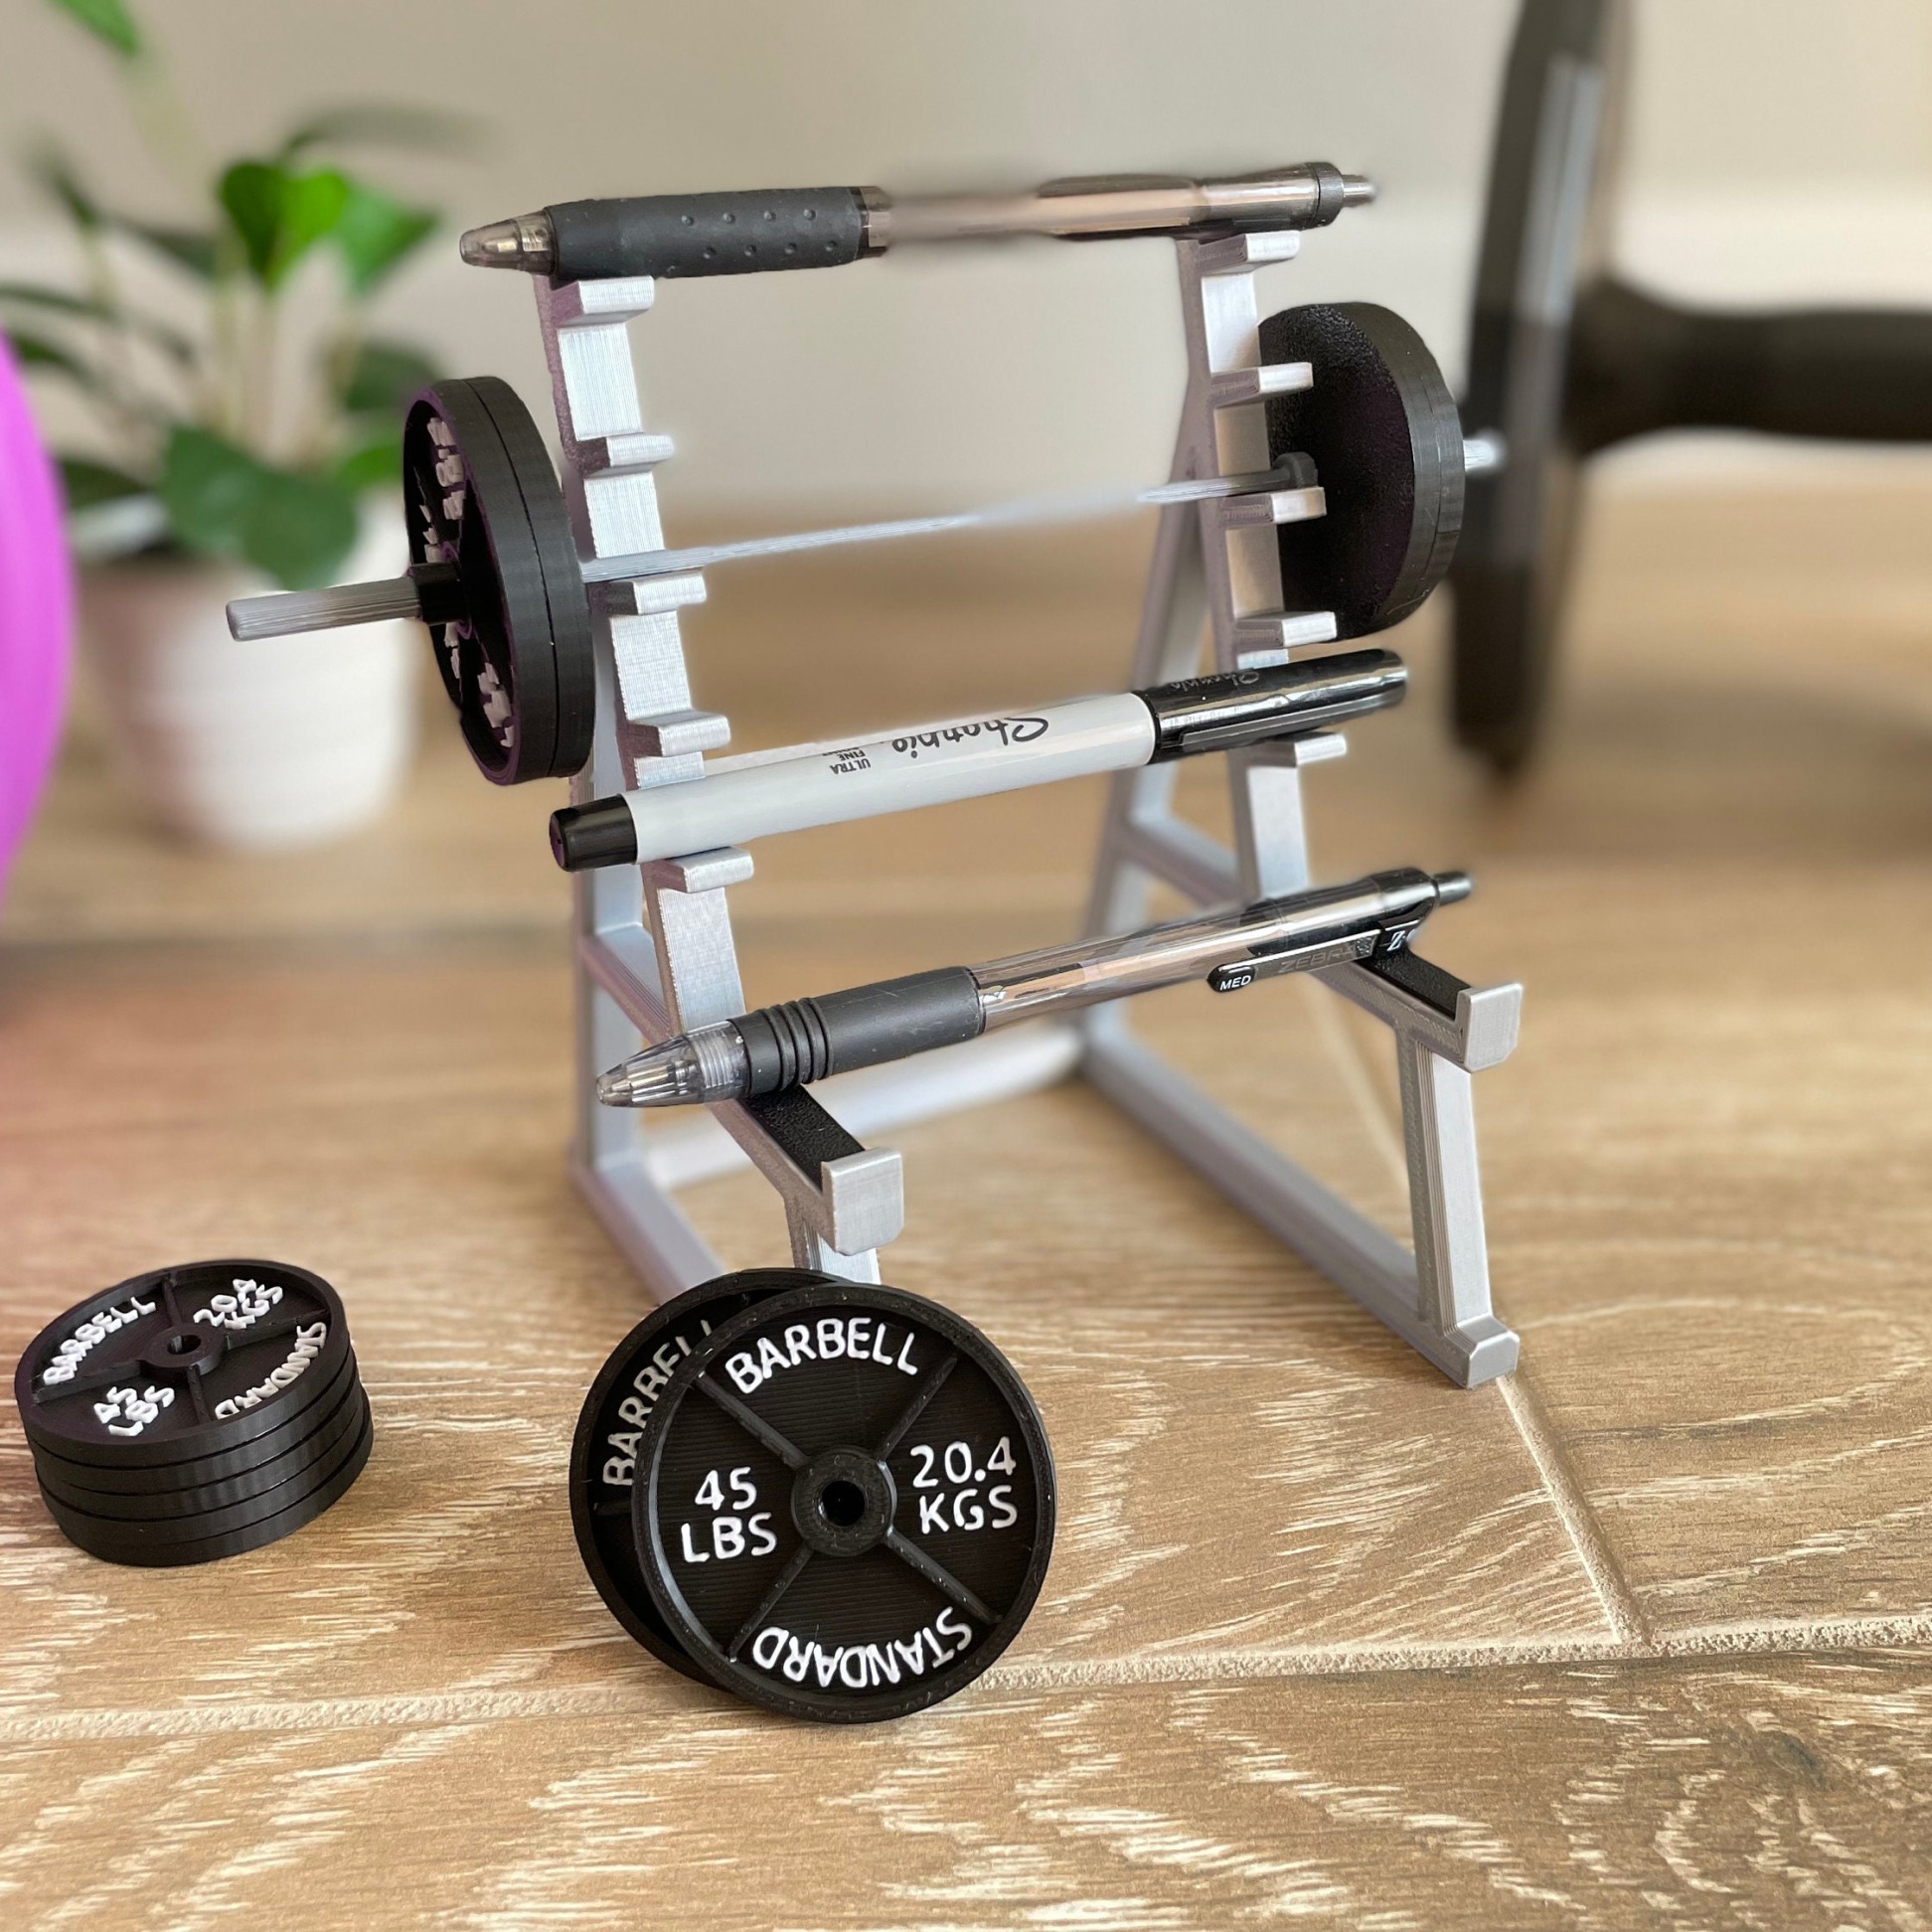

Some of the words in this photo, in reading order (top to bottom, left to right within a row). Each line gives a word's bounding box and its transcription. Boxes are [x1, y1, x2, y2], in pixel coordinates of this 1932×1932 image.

[829, 758, 872, 775] ULTRA
[836, 749, 866, 761] FINE
[1219, 974, 1252, 992] MED
[224, 1284, 283, 1330] KGS
[43, 1296, 157, 1385] BARBELL
[725, 1317, 919, 1394] BARBELL
[93, 1385, 139, 1424] 45
[107, 1384, 175, 1437] LBS
[909, 1436, 1017, 1489] 20.4
[694, 1467, 758, 1512] 45
[918, 1484, 1019, 1535] KGS
[681, 1512, 778, 1563] LBS
[751, 1606, 973, 1689] STANDARD
